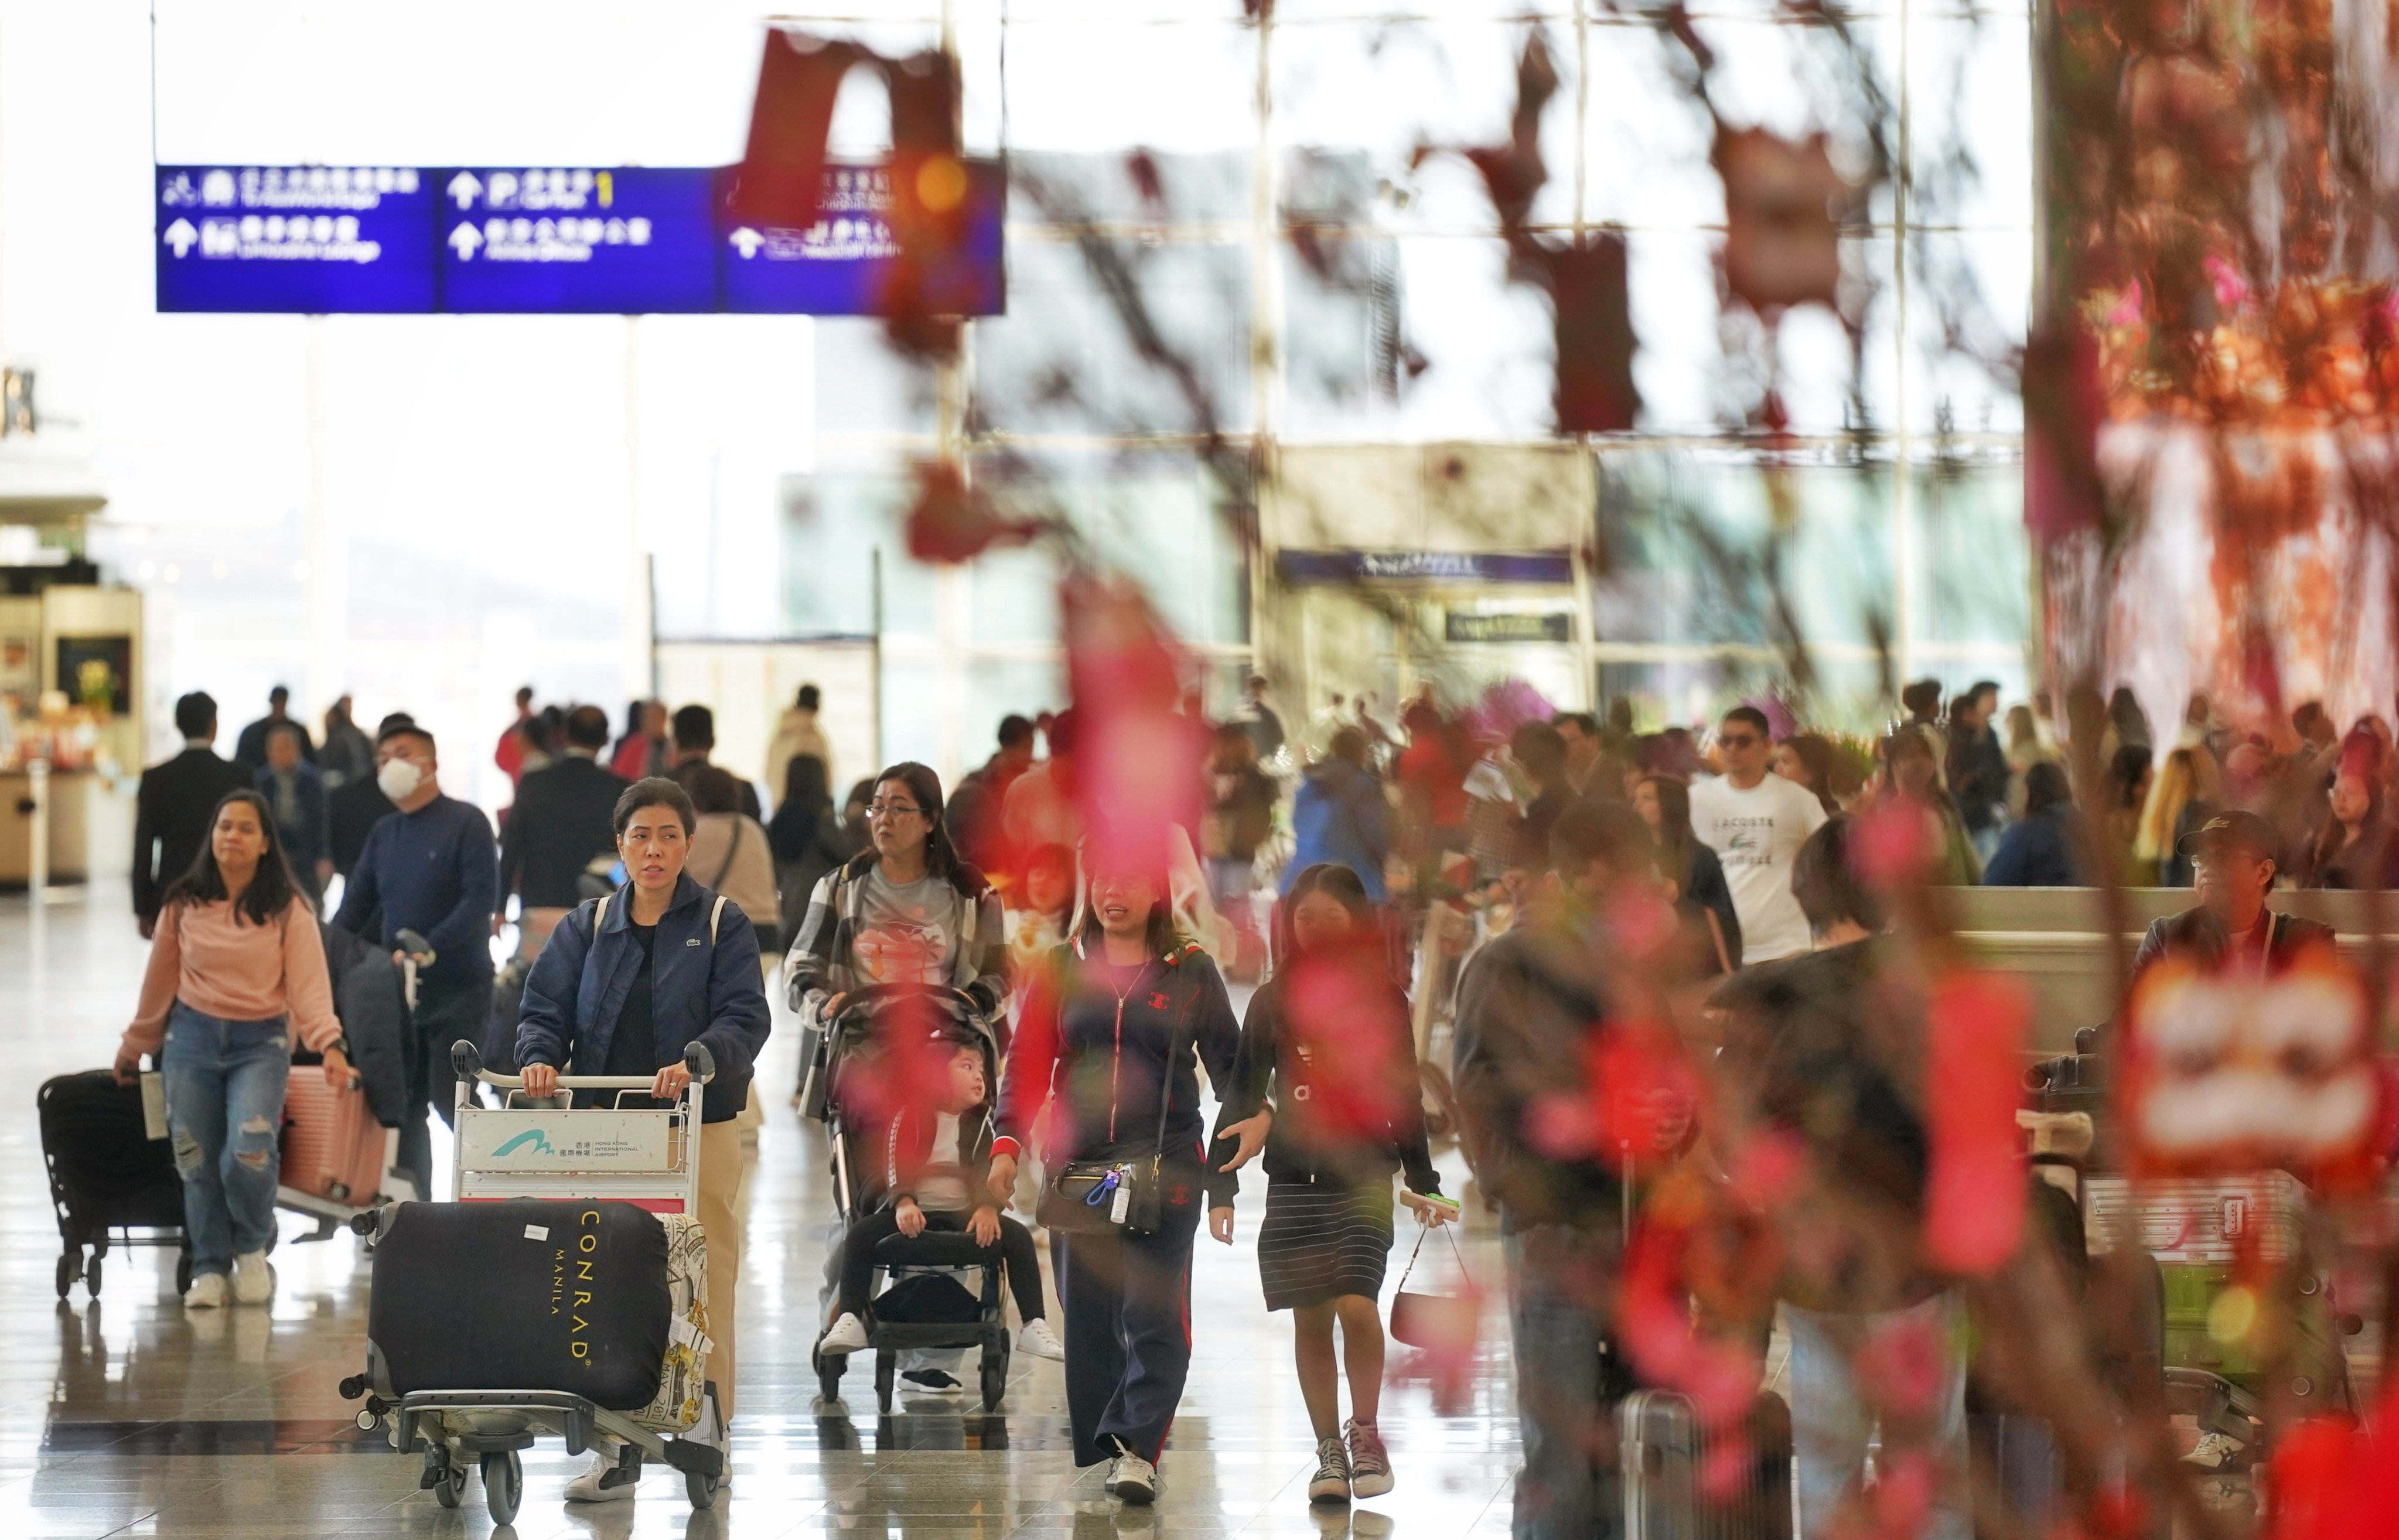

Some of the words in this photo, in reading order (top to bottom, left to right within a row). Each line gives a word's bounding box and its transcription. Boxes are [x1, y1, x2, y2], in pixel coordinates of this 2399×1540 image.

[1711, 817, 1773, 828] LACOSTE
[552, 1249, 565, 1315] MANILA
[571, 1210, 600, 1358] CONRAD
[660, 1364, 671, 1389] MAY
